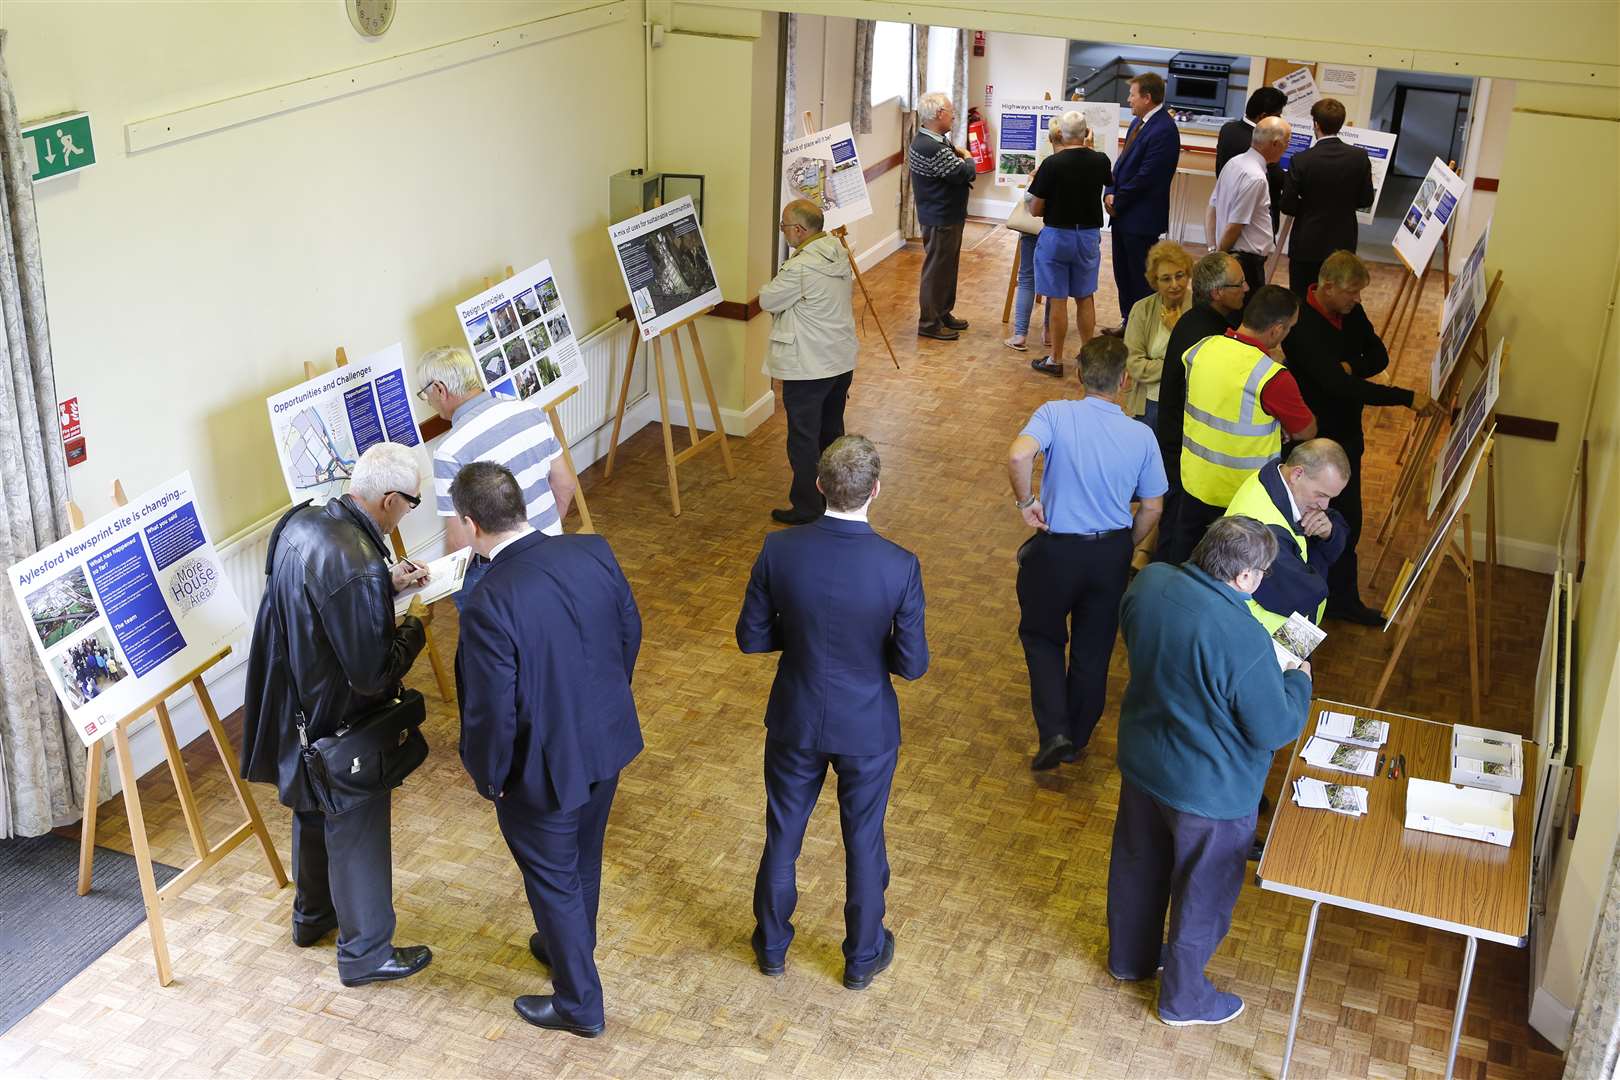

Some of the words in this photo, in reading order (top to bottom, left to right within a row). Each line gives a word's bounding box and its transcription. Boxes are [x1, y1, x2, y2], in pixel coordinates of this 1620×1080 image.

[1001, 103, 1030, 111] Highways
[647, 212, 668, 224] sustainable
[462, 303, 481, 319] Design
[480, 292, 505, 311] principles
[273, 386, 322, 413] Opportunities
[322, 380, 336, 392] and
[336, 365, 372, 387] Challenges
[146, 523, 159, 534] What
[158, 519, 169, 530] you
[168, 513, 178, 522] said
[19, 551, 65, 586] Aylesford
[65, 527, 114, 560] Newsprint
[113, 515, 131, 532] Site
[132, 511, 141, 522] is
[141, 489, 187, 517] changing...
[89, 555, 104, 568] What
[103, 550, 113, 561] has
[112, 536, 137, 555] happened
[98, 562, 109, 573] far?
[177, 562, 203, 583] More
[190, 587, 212, 608] Area
[114, 619, 125, 632] The
[124, 613, 138, 627] team
